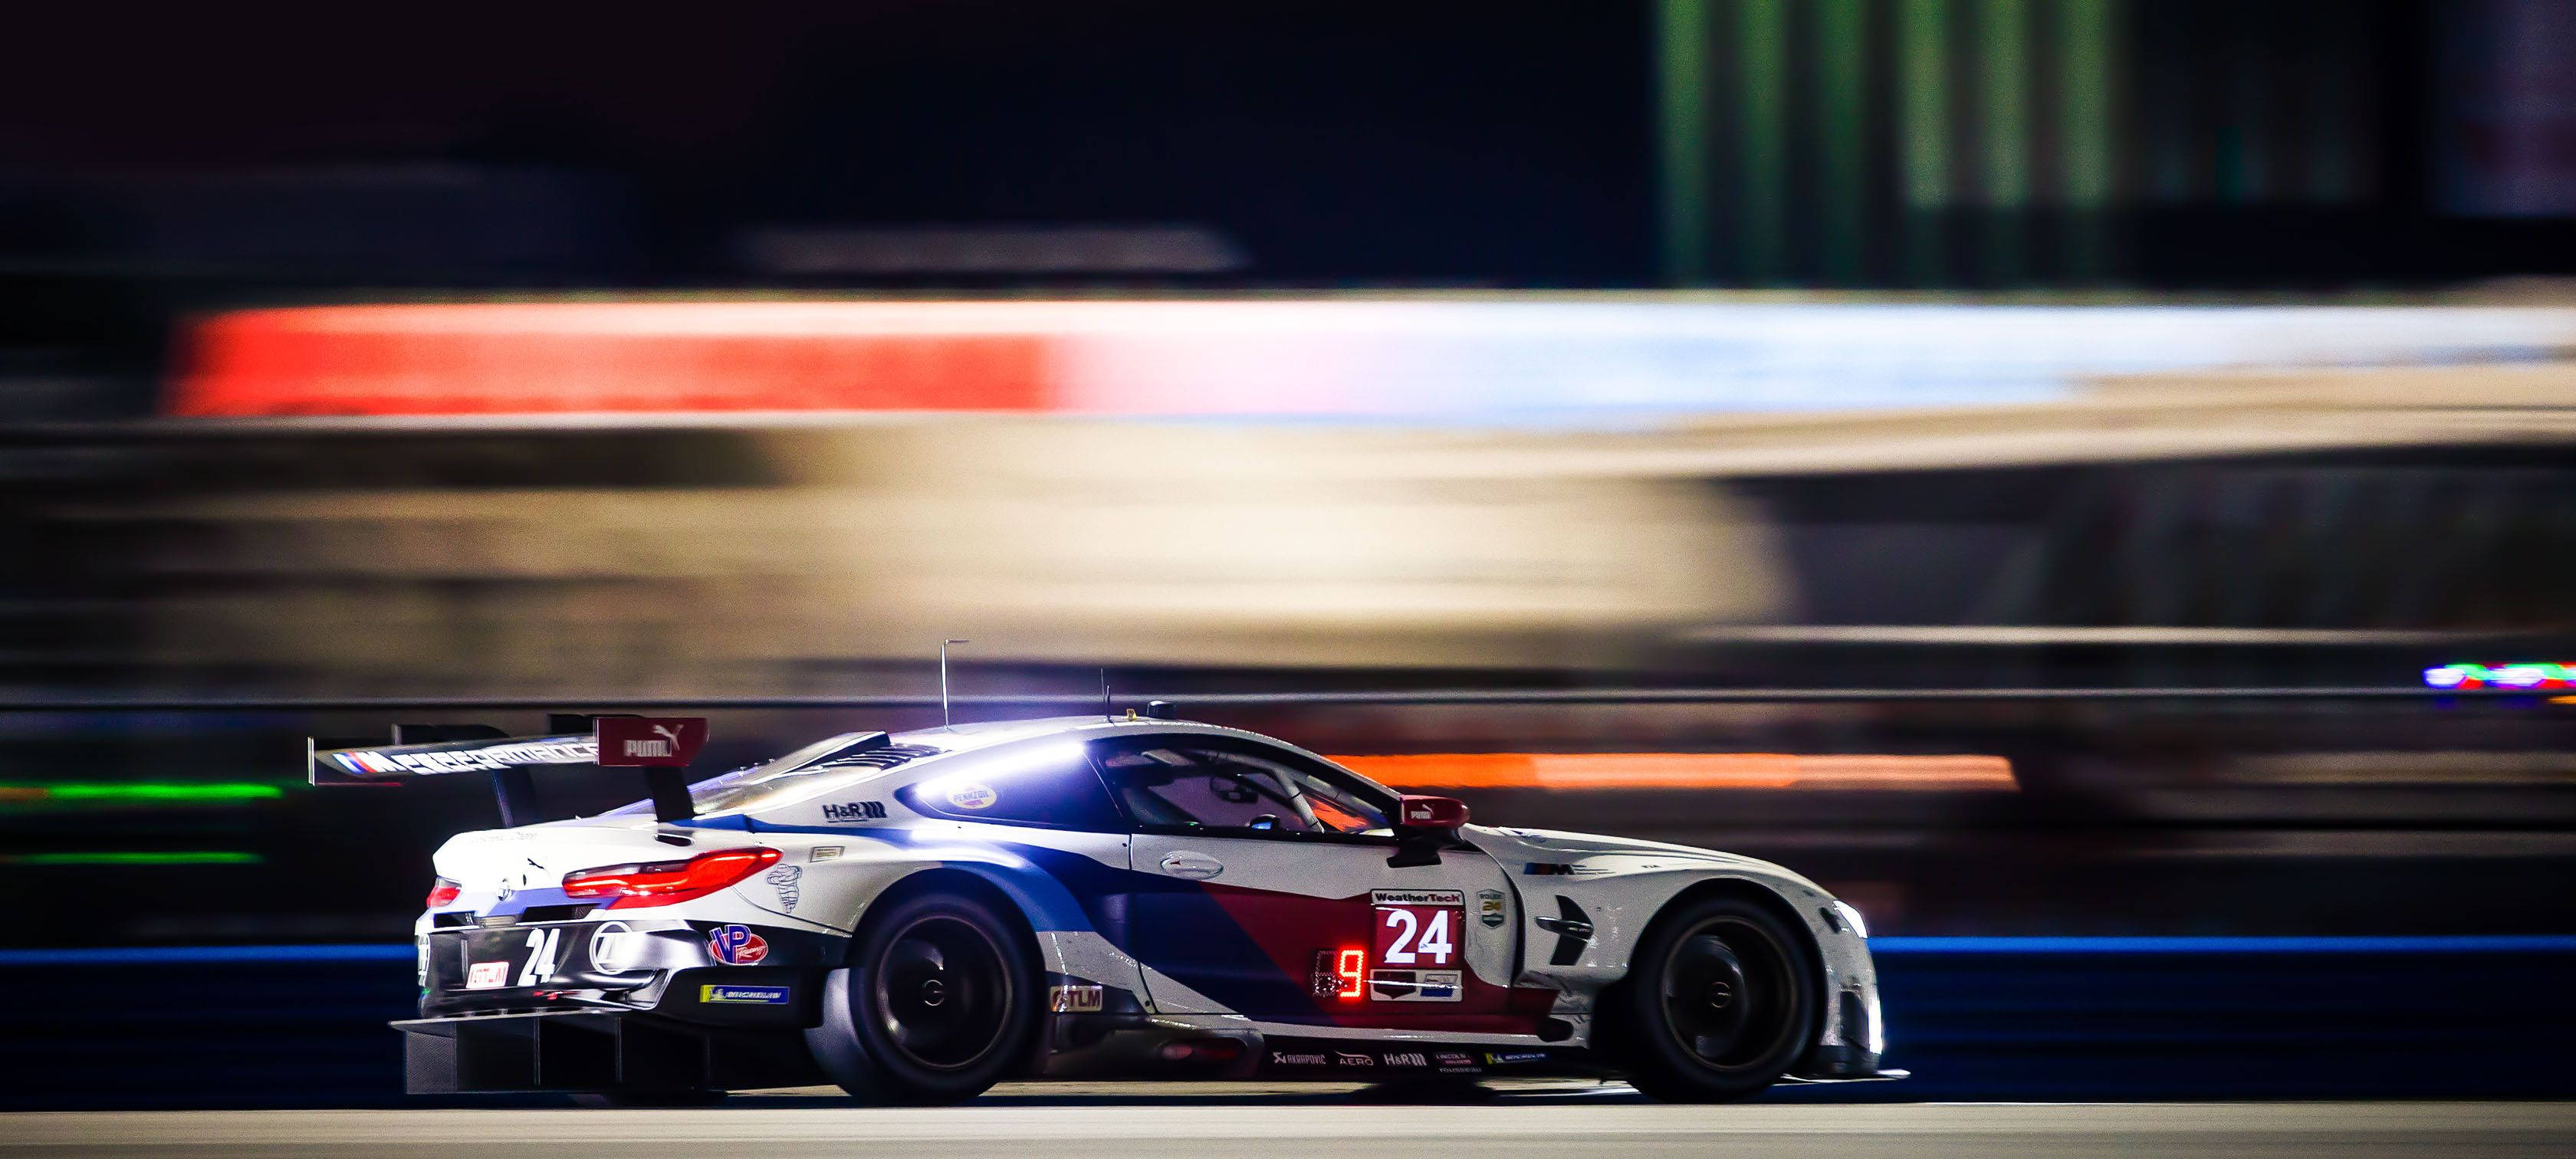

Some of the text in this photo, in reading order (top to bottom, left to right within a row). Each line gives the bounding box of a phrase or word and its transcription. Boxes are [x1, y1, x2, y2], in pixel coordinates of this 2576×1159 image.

[1375, 893, 1460, 903] WeatherTech
[517, 928, 560, 986] 24
[709, 924, 751, 965] VP
[1384, 909, 1453, 964] 24
[1339, 950, 1364, 997] 9
[1339, 1058, 1374, 1066] AERO
